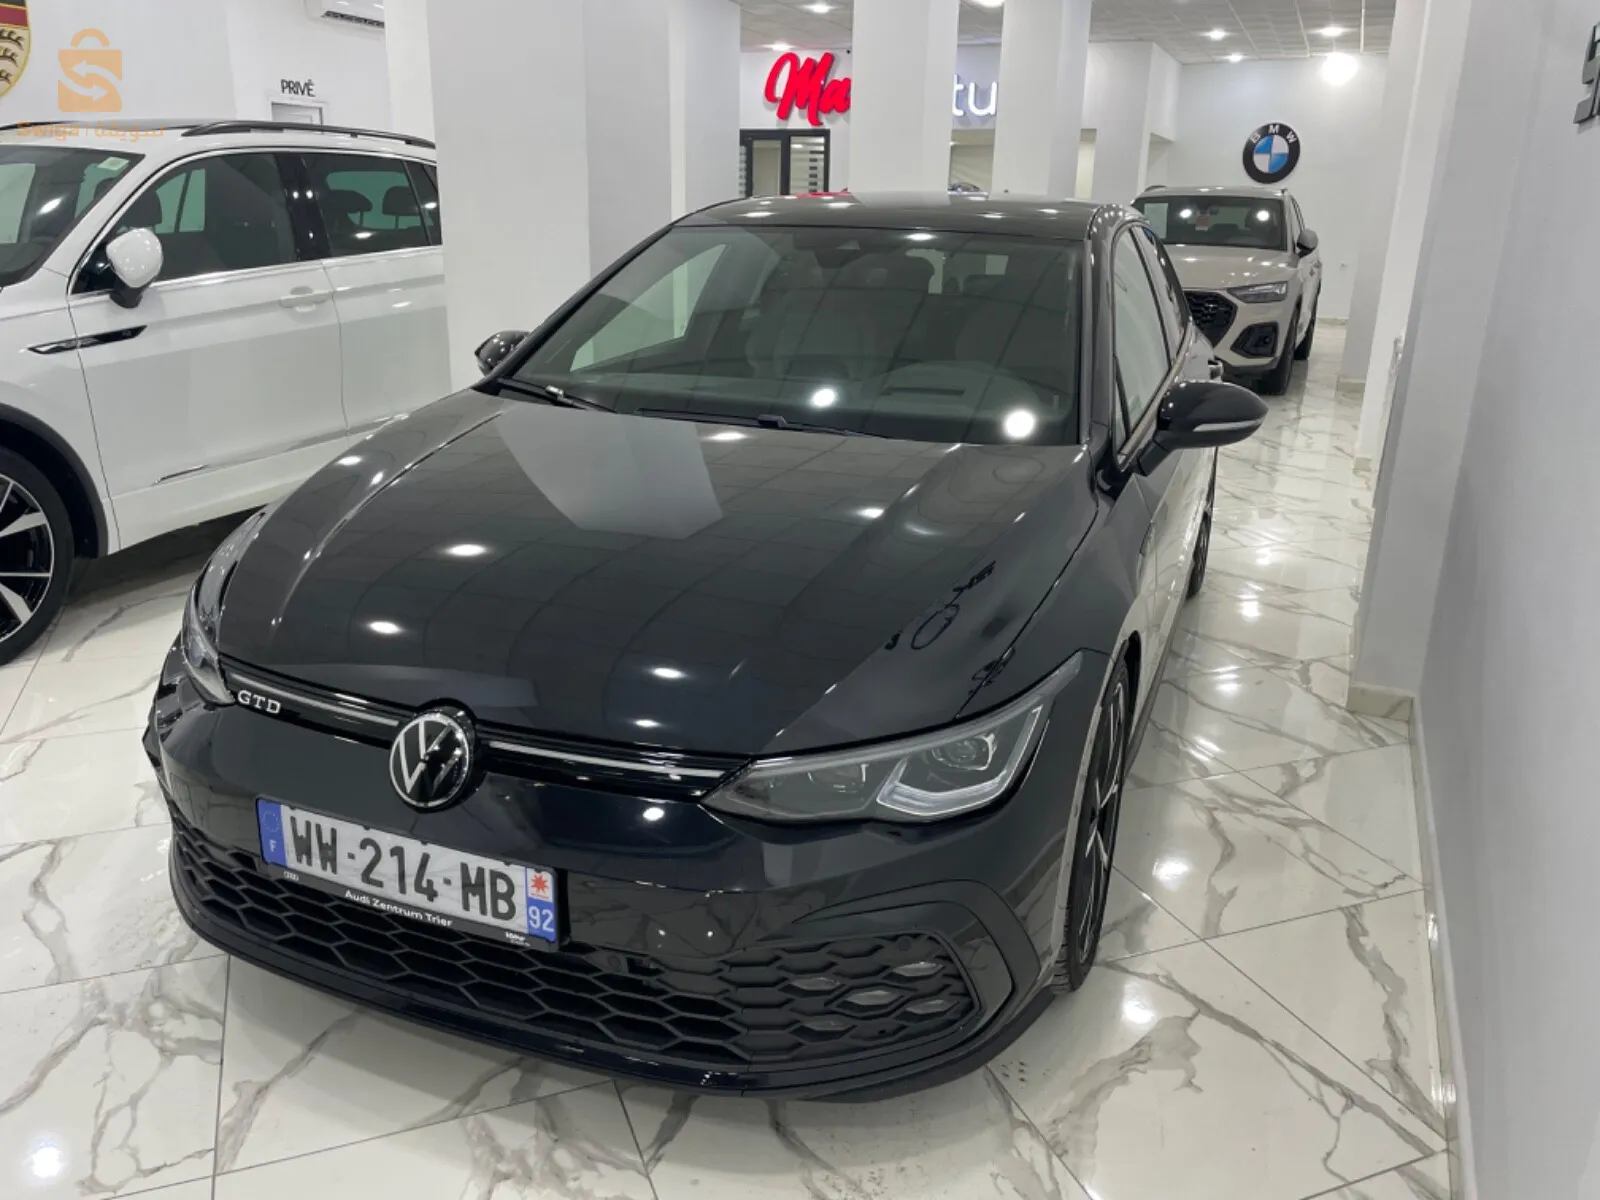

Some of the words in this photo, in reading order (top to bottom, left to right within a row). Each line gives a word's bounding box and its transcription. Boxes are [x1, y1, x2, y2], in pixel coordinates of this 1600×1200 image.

[1250, 123, 1298, 144] BMW
[237, 690, 281, 714] GTD
[290, 815, 517, 922] WW-214-MB
[345, 889, 371, 905] Audi
[372, 897, 423, 920] Zentrum
[425, 912, 453, 928] Trier
[528, 905, 555, 933] 92
